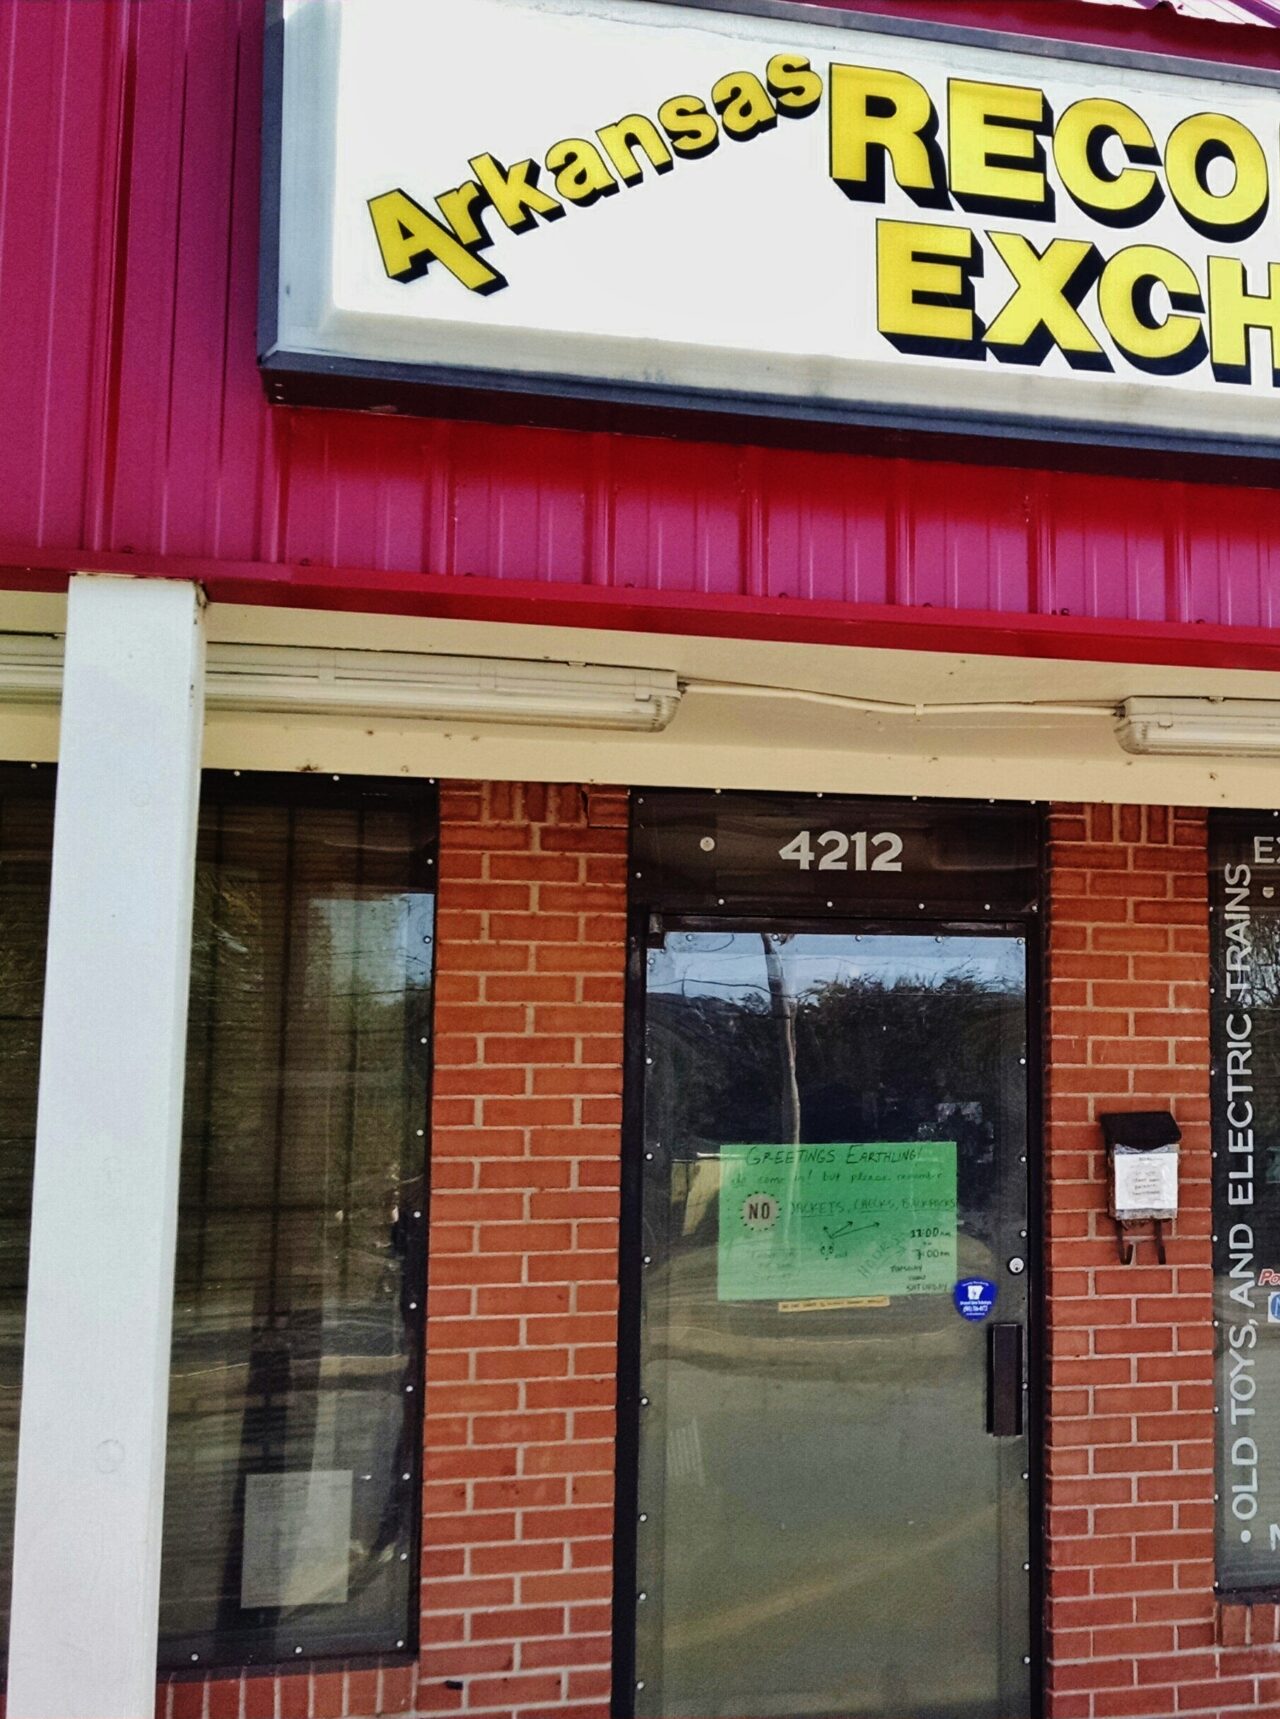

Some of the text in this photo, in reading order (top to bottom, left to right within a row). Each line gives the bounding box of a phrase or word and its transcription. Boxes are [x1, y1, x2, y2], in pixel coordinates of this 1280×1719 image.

[366, 53, 823, 296] Arkansas
[779, 831, 903, 872] 4212
[745, 1146, 836, 1166] GREETINGS
[1224, 862, 1258, 1521] OLD TOYS, AND ELECTRIC TRAINS
[748, 1202, 771, 1220] NO
[910, 1227, 939, 1238] 11:00
[911, 1249, 939, 1261] 7:00
